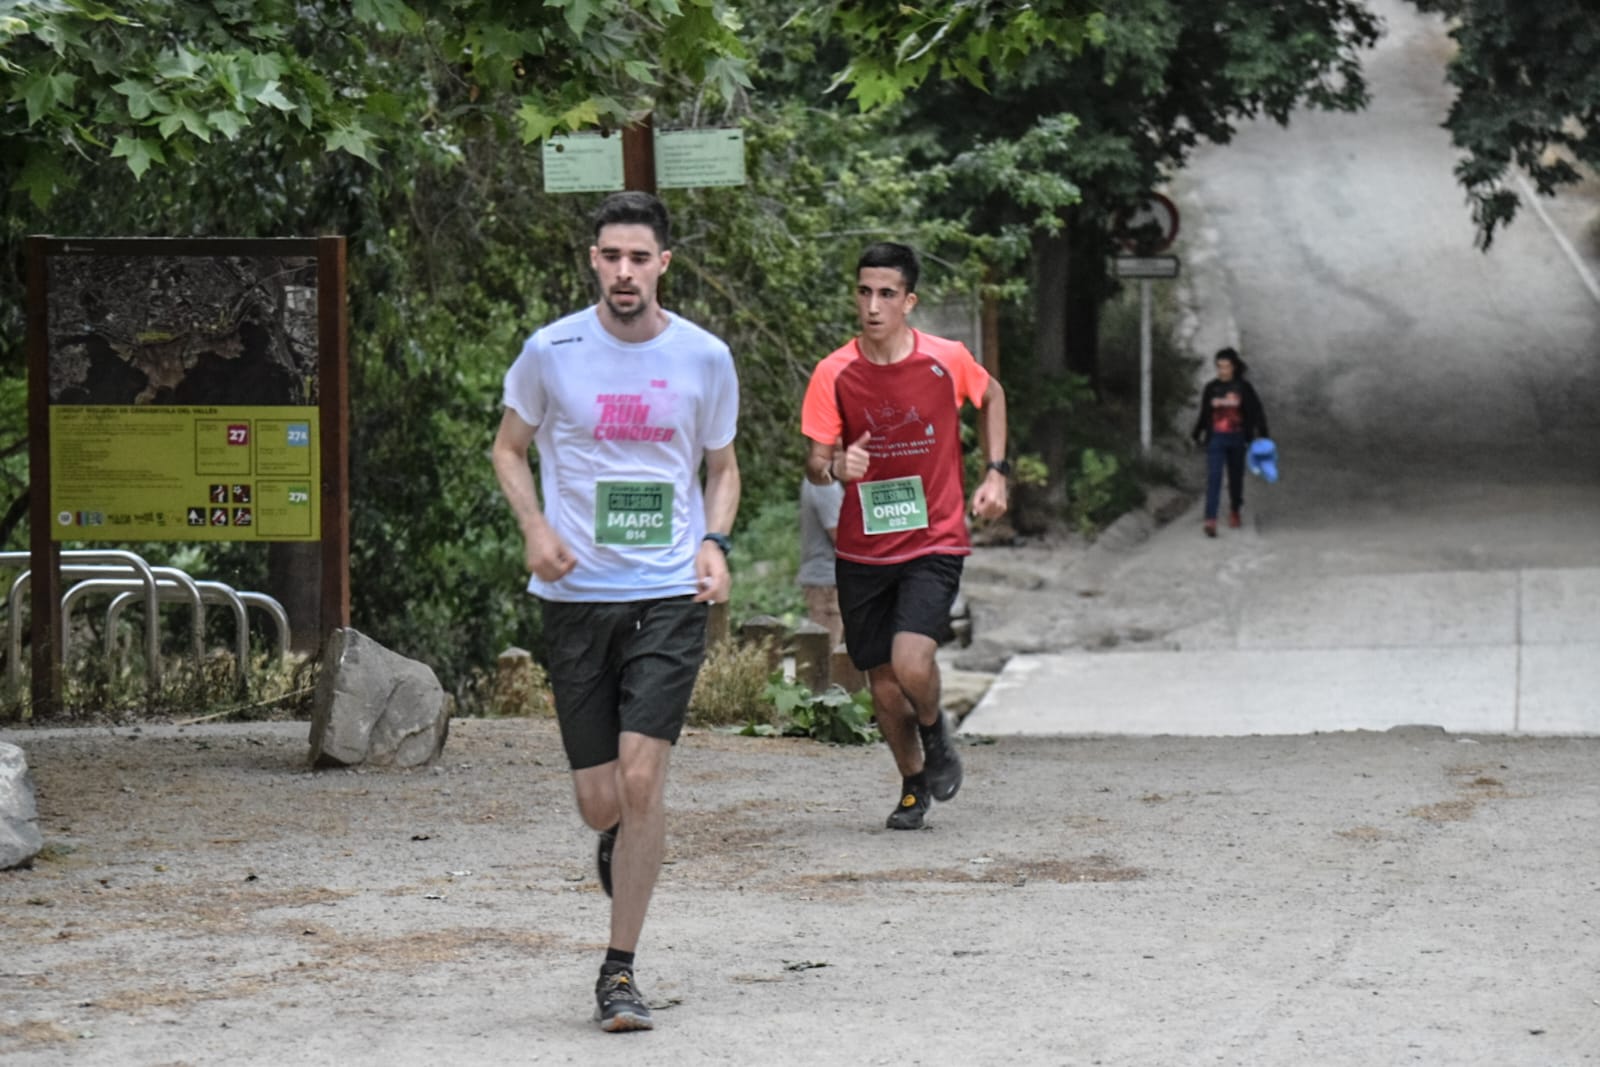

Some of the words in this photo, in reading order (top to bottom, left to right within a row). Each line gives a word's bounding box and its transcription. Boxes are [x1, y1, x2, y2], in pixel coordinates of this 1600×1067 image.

[602, 404, 649, 424] RUN
[229, 429, 246, 441] 27
[288, 431, 308, 441] 27A
[594, 425, 675, 442] CONQUER
[873, 502, 920, 518] ORIOL
[607, 512, 664, 528] MARC
